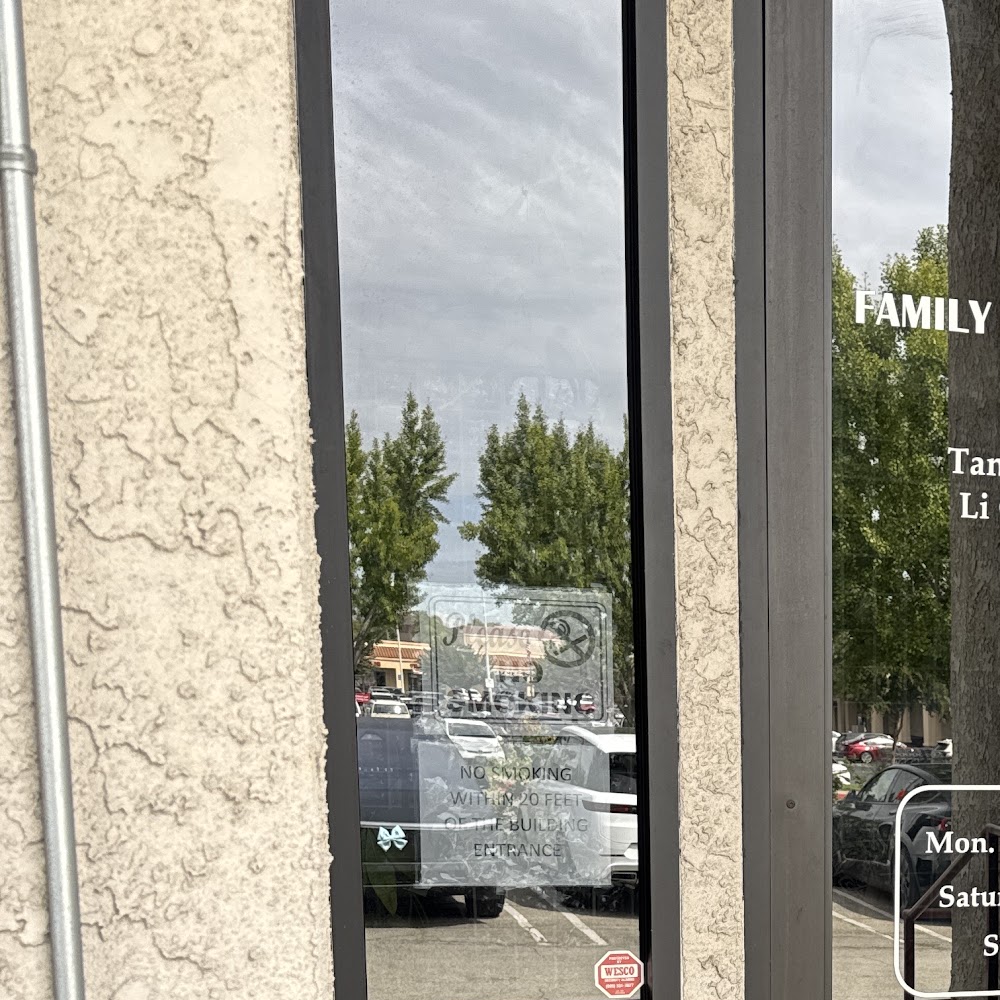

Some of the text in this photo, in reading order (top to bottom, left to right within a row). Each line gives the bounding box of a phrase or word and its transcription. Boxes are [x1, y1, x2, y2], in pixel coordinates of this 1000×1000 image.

[855, 290, 992, 334] FAMILY
[960, 493, 988, 520] Li
[460, 766, 572, 781] NO SMOKING
[451, 791, 582, 806] WITHIN 20 FEET
[472, 818, 503, 832] THE
[509, 818, 589, 832] BUILDING
[474, 843, 562, 857] ENTRANCE
[925, 832, 995, 854] Mon.
[604, 966, 635, 976] WESCO
